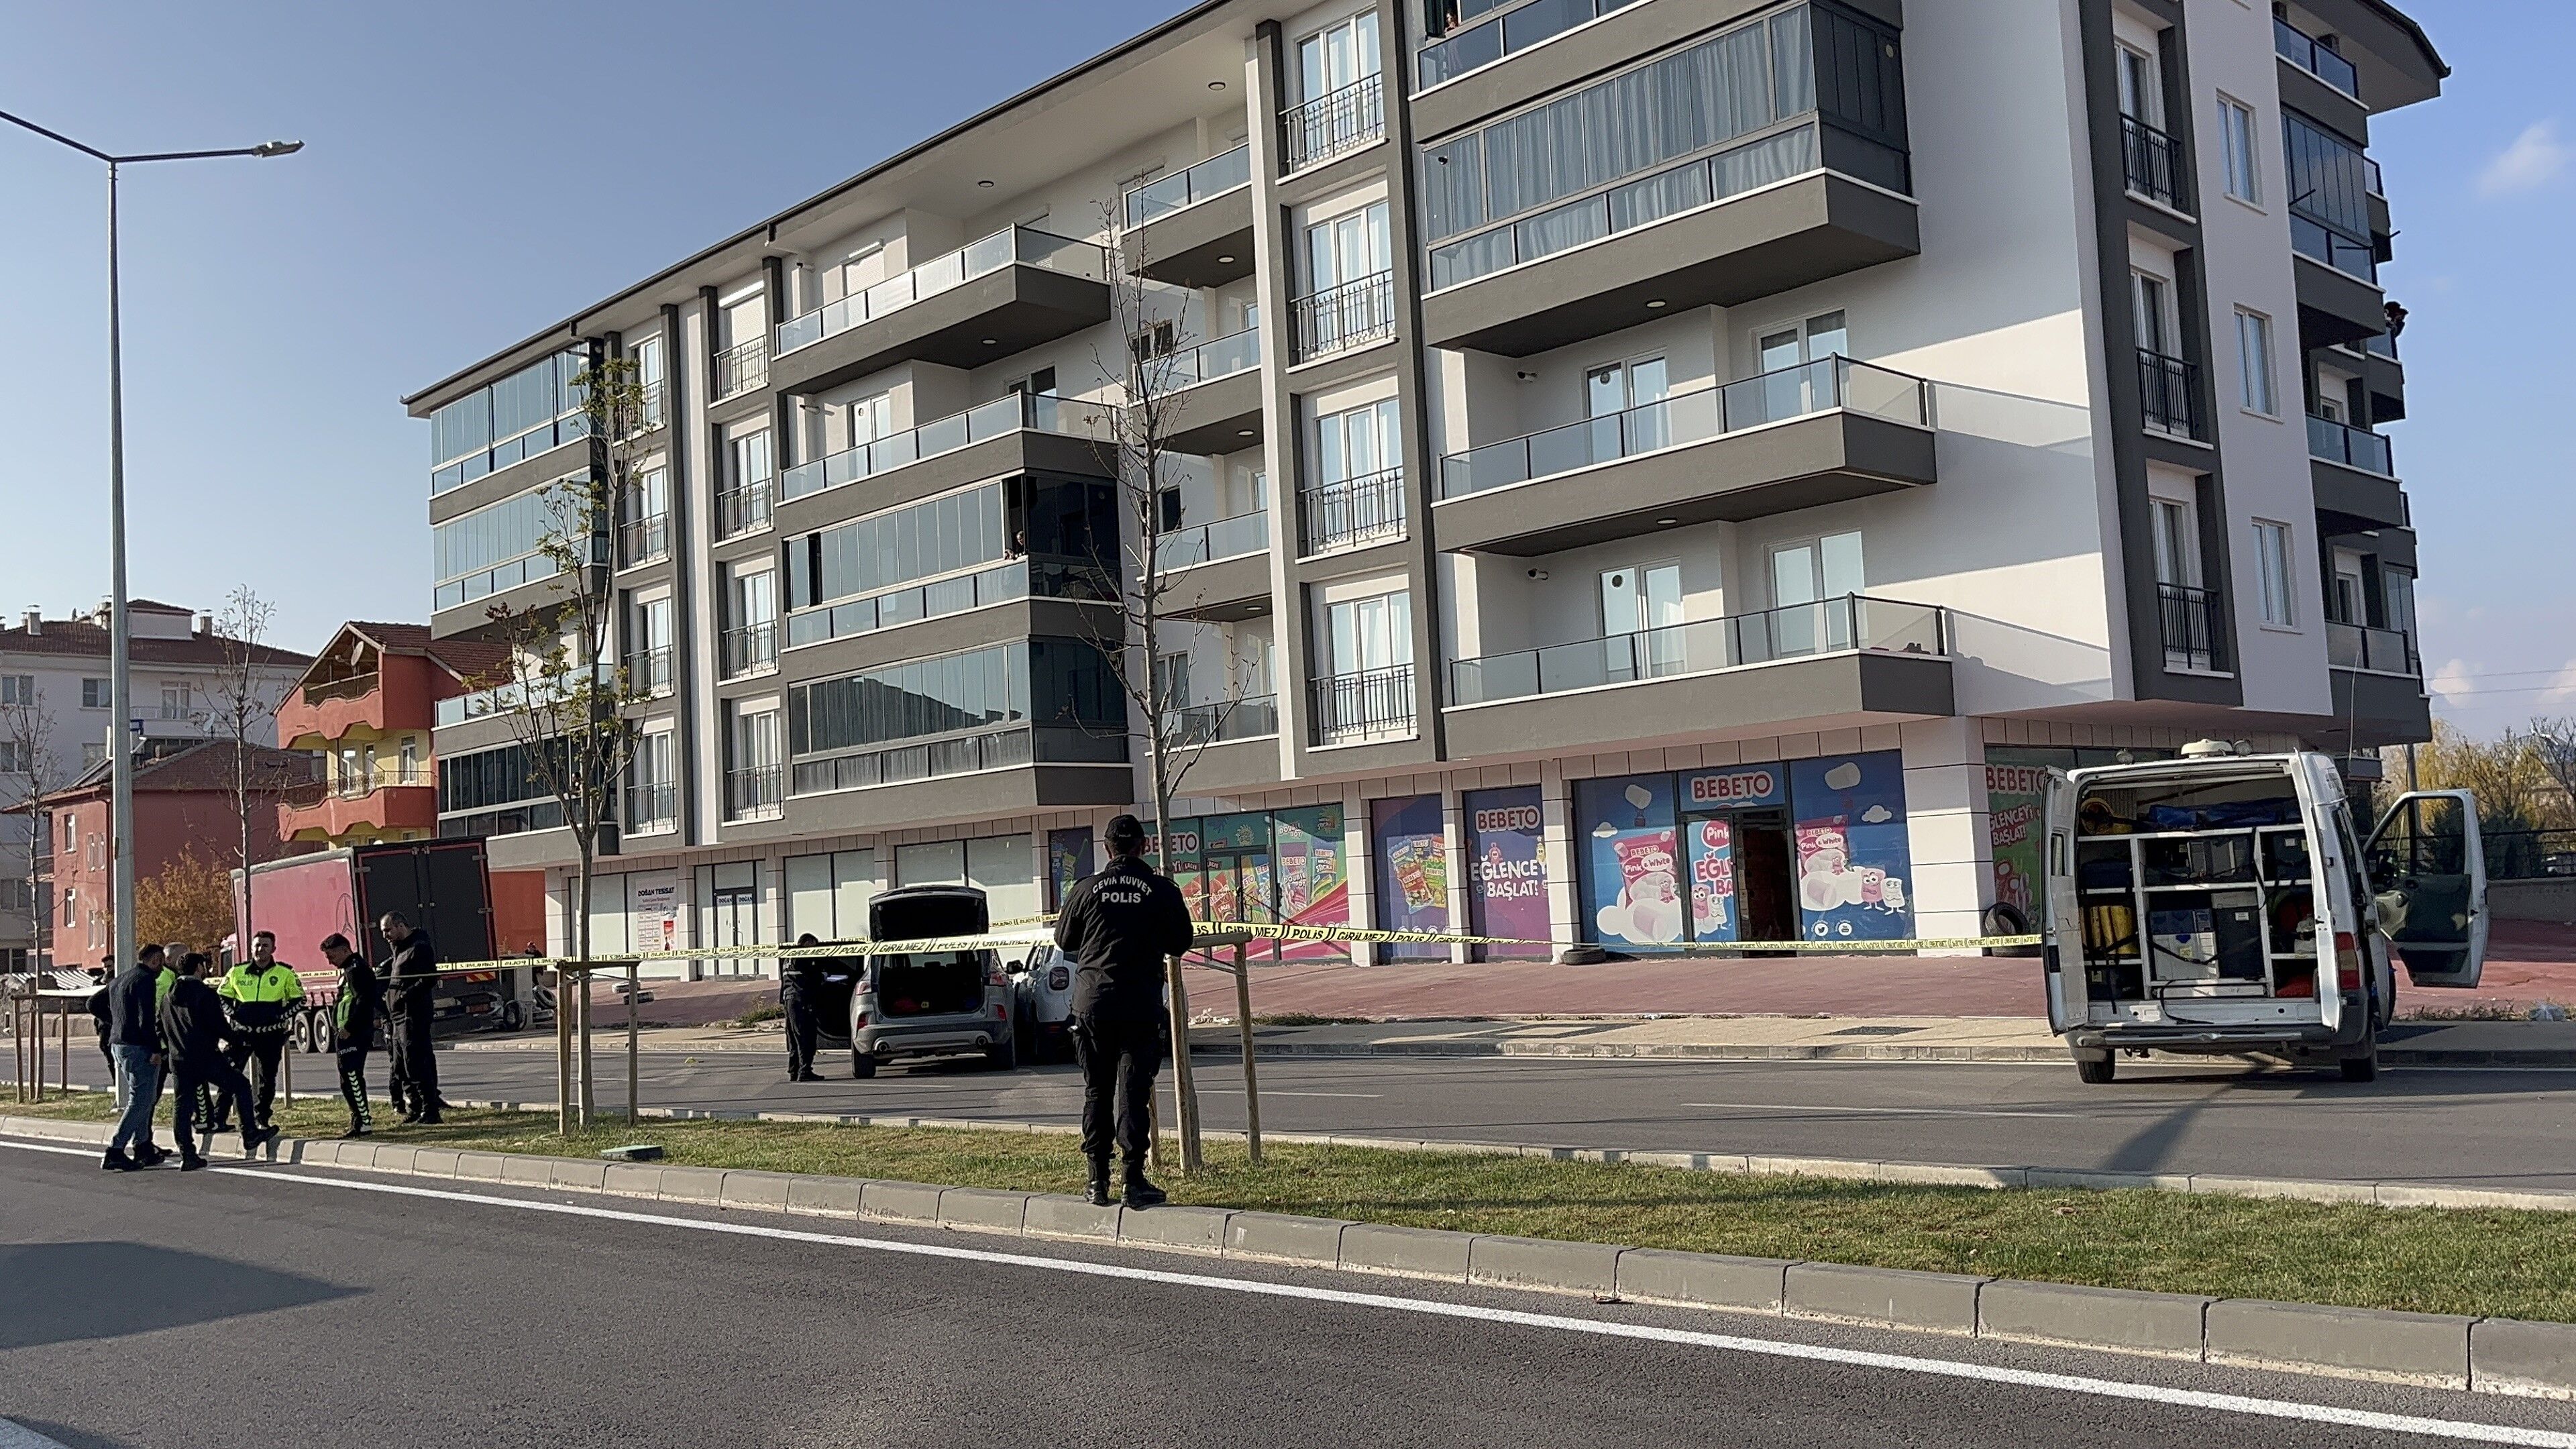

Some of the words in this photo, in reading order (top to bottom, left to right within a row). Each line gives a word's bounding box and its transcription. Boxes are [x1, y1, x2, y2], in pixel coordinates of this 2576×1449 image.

[1693, 774, 1770, 799] BEBETO
[1477, 808, 1538, 830] BEBETO
[1707, 826, 1729, 841] Pink
[1823, 837, 1841, 845] White
[1142, 834, 1197, 855] BEETO
[1631, 847, 1658, 855] BEBETO
[1282, 857, 1306, 865] BEBETO
[1625, 864, 1642, 873] Pink
[1648, 857, 1670, 867] White
[1120, 875, 1152, 896] KUVVET
[1487, 880, 1539, 901] BAŞLAT!
